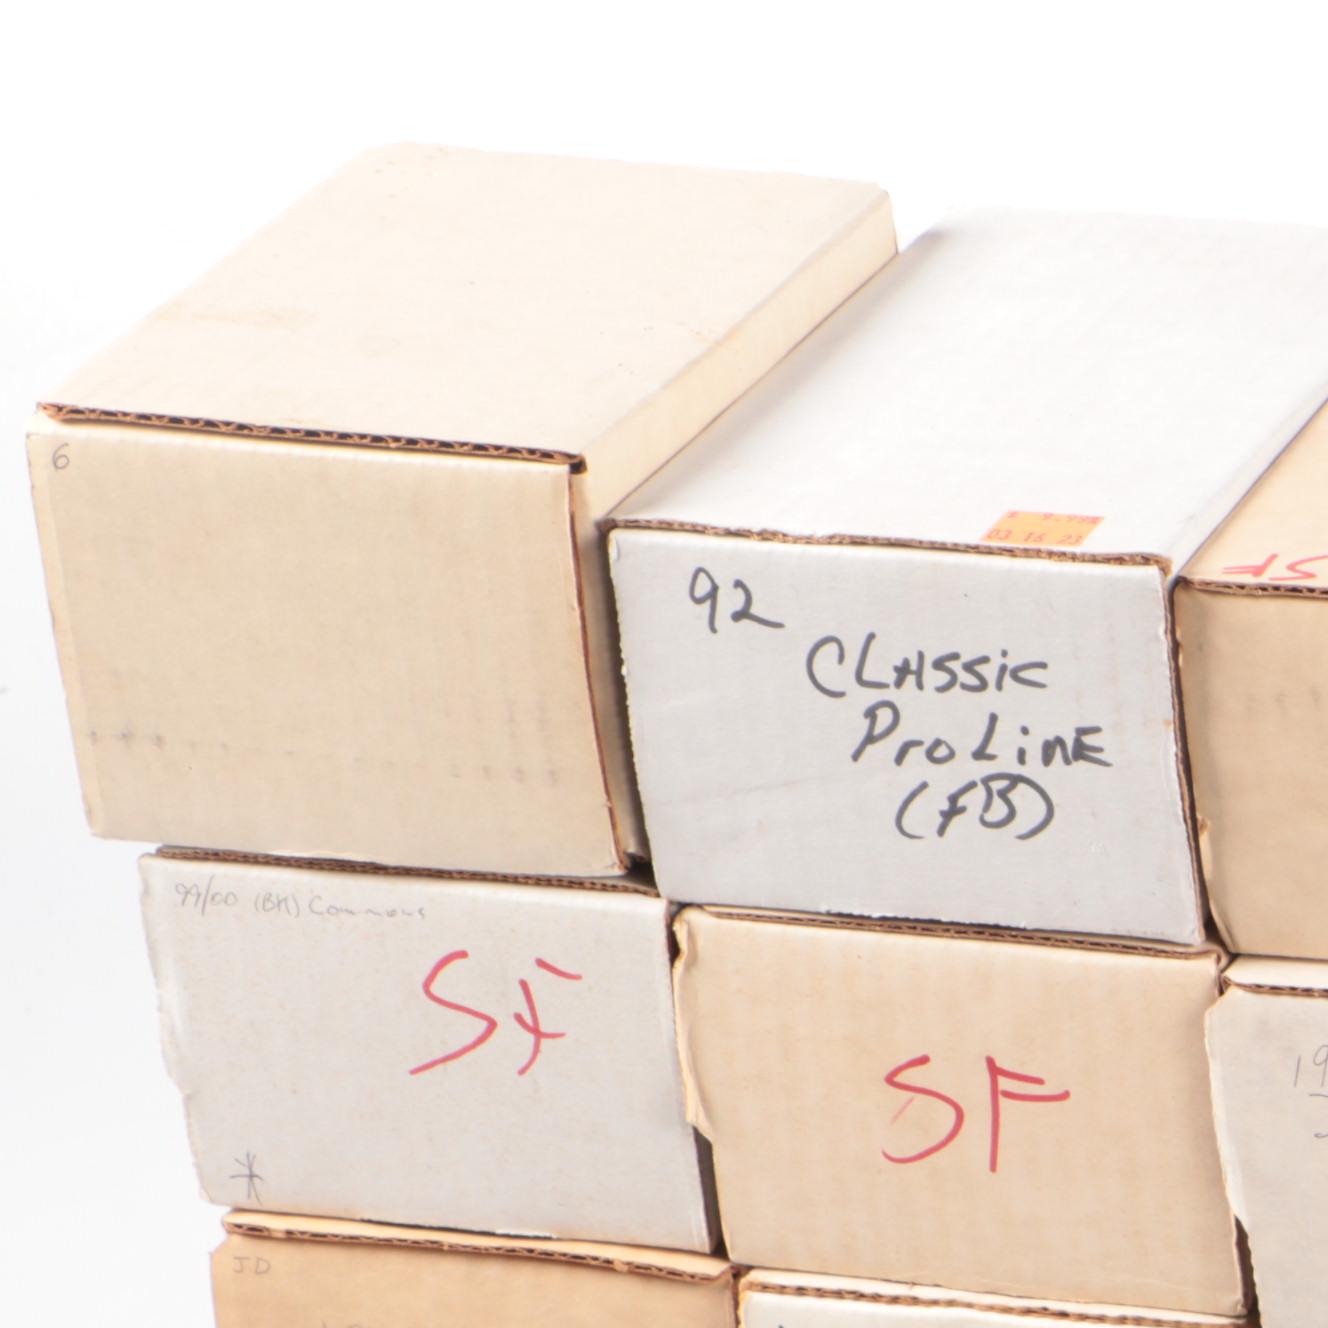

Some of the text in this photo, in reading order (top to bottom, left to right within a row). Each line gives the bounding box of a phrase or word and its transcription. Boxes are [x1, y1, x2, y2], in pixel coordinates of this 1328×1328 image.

[52, 442, 70, 470] 6
[689, 567, 785, 634] 92
[882, 1054, 1070, 1173] SF
